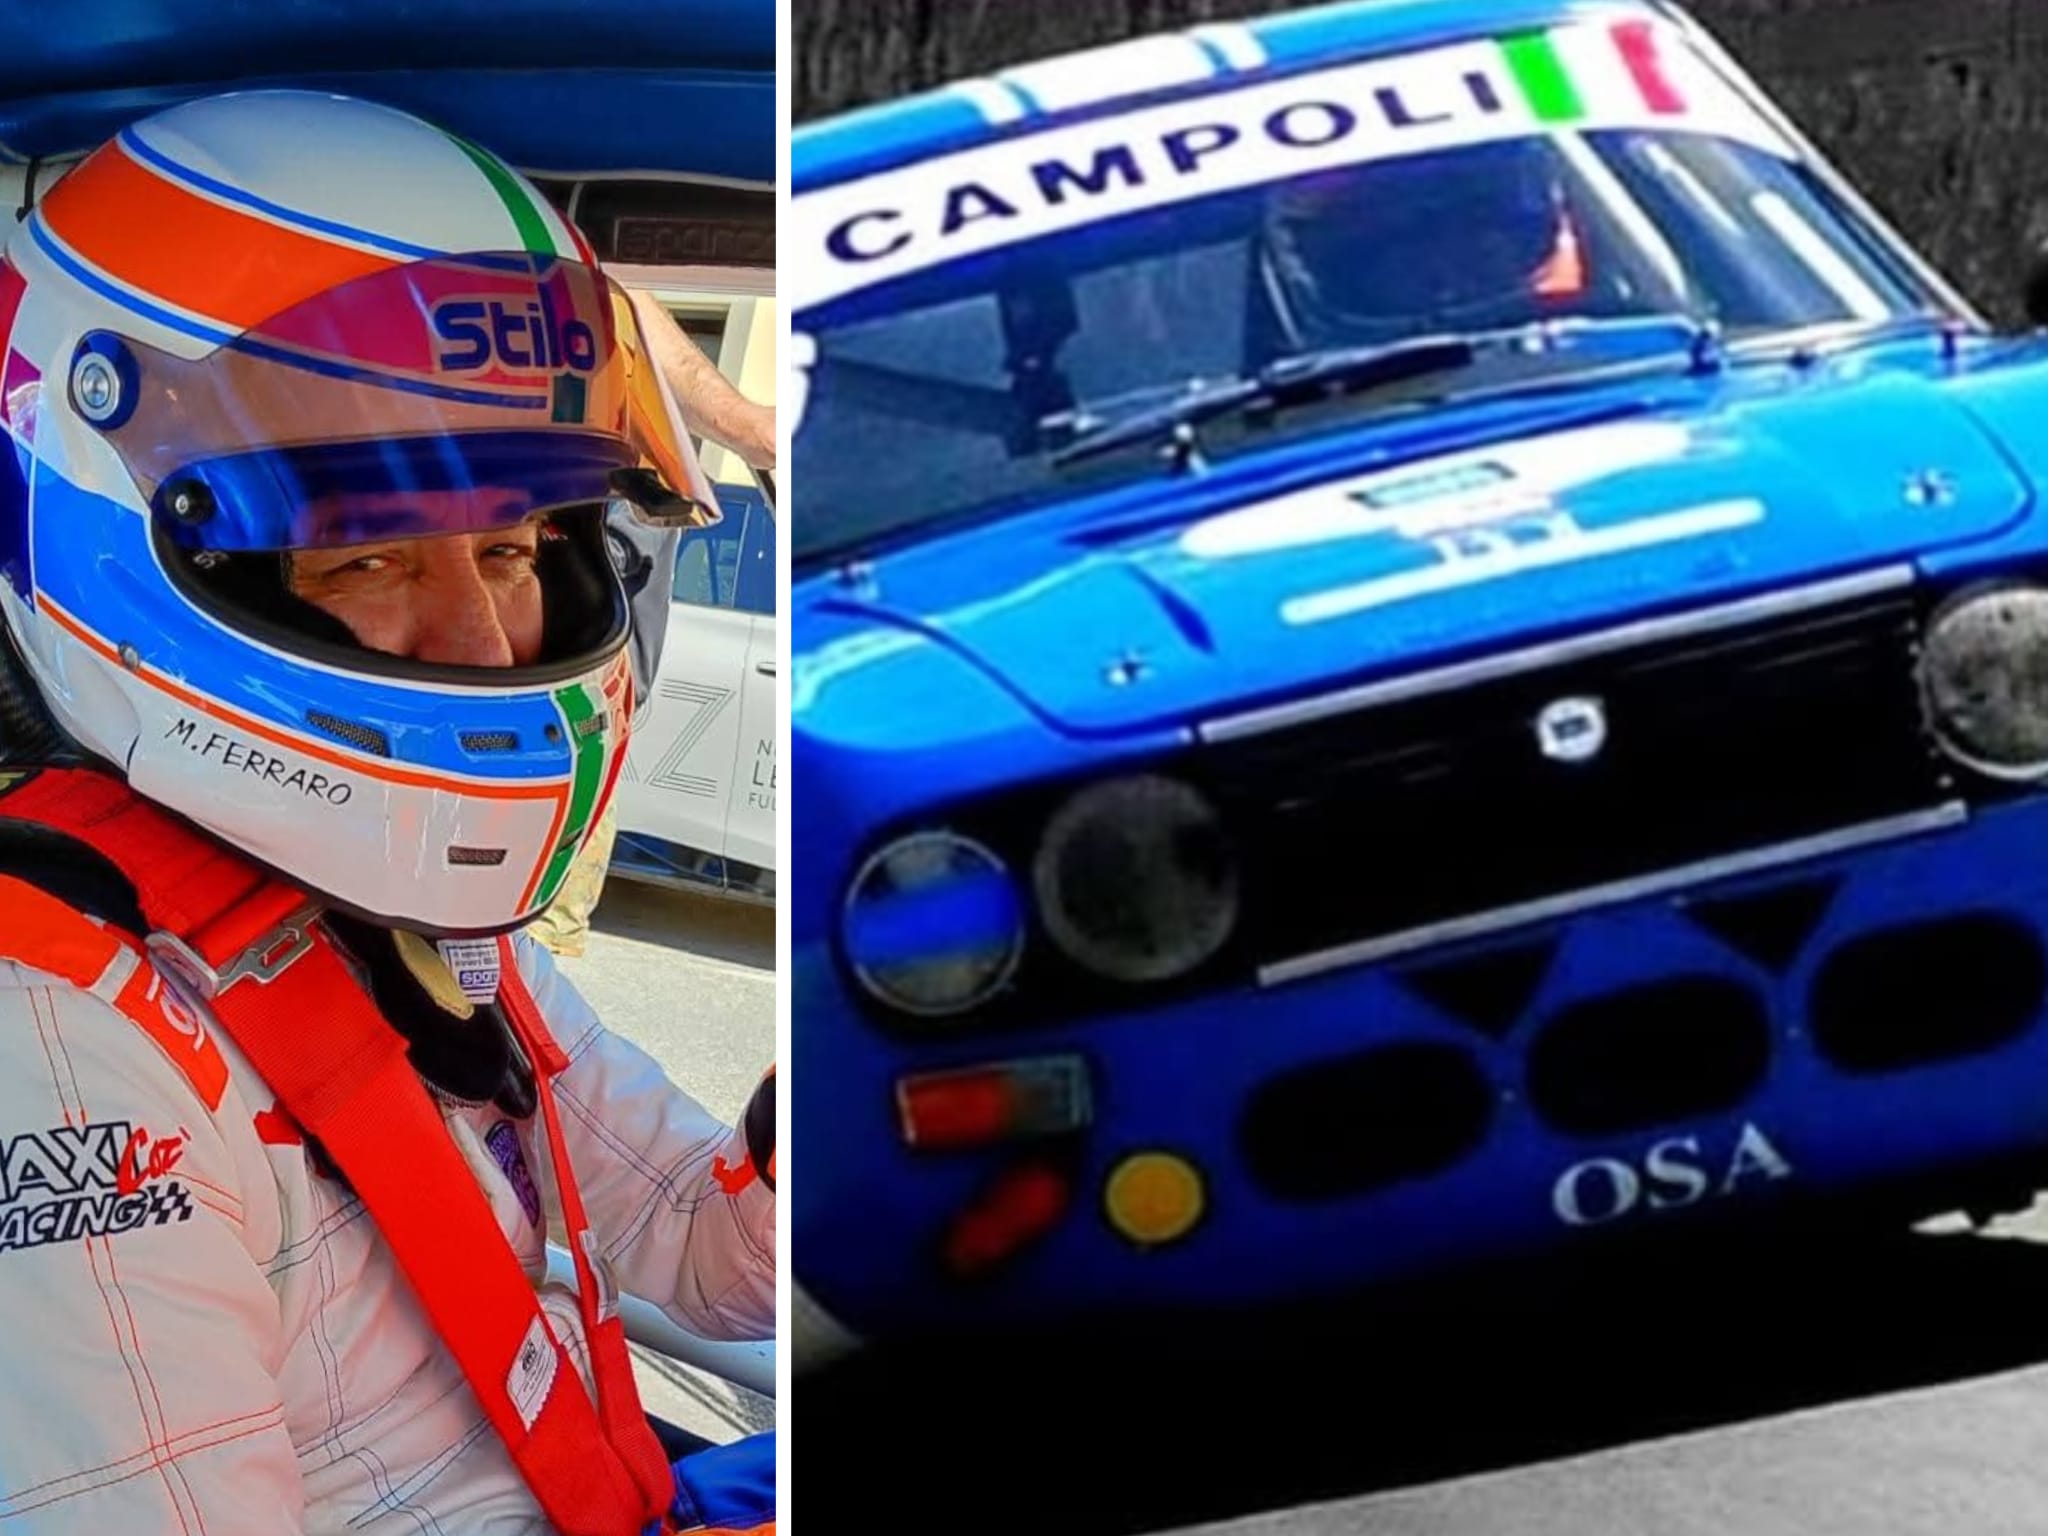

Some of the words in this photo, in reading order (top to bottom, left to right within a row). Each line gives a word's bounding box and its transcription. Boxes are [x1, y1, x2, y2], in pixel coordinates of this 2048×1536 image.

[825, 70, 1504, 263] CAMPOLI
[433, 282, 597, 372] Stilo
[0, 1120, 139, 1203] AXI
[1552, 1120, 1793, 1227] OSA
[0, 1189, 149, 1254] ACING
